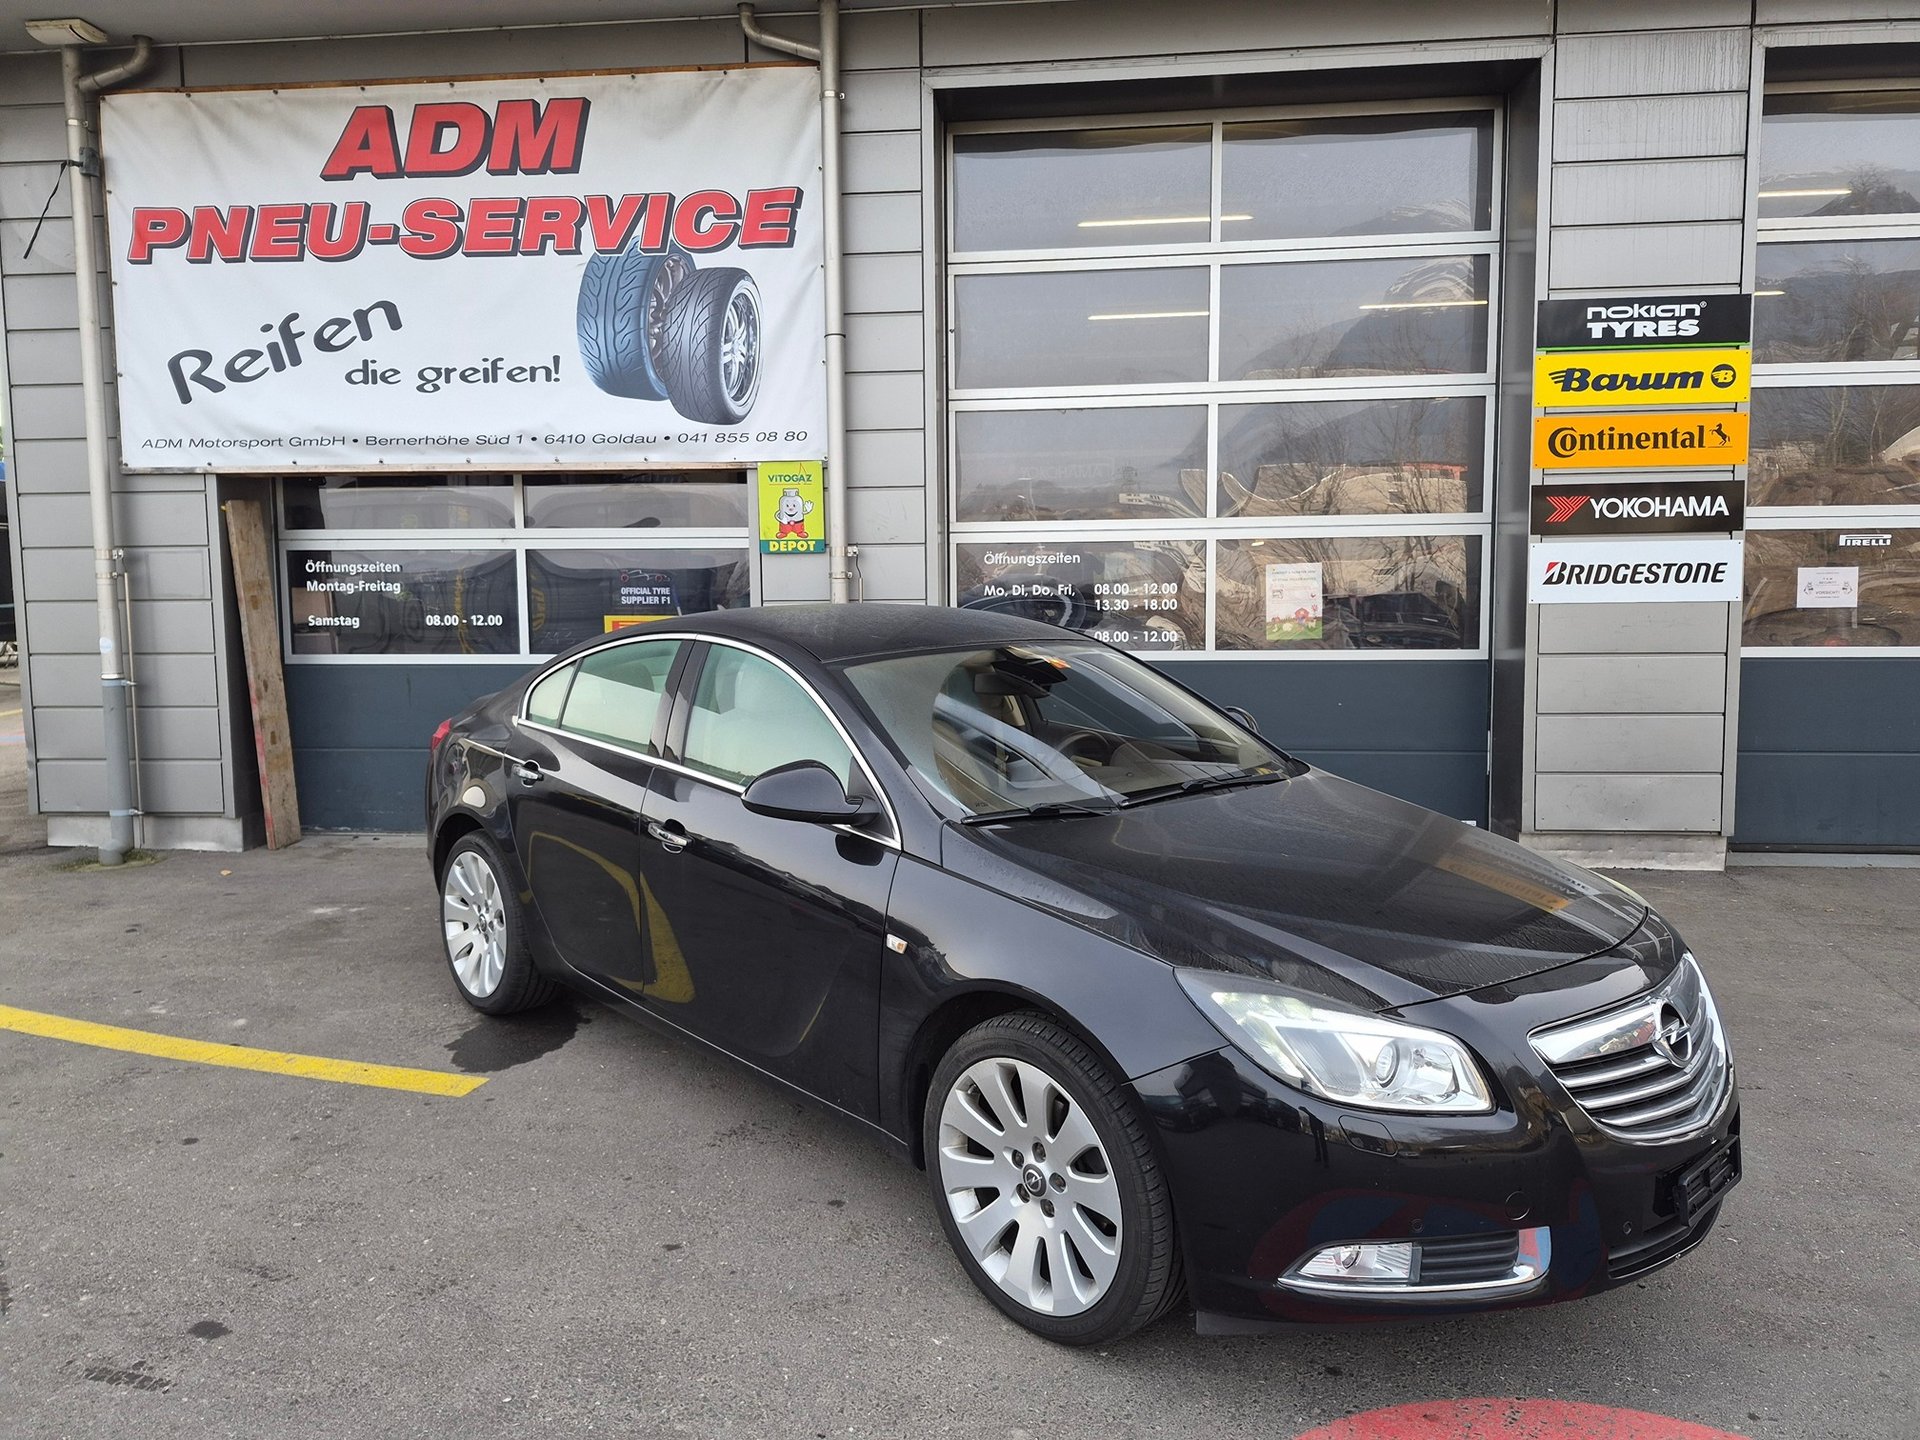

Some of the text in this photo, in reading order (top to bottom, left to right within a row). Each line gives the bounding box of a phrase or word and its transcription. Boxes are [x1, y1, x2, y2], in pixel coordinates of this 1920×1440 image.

[319, 97, 592, 182] ADM
[127, 187, 804, 265] PNEU-SERVICE
[1587, 319, 1700, 339] TYRES
[166, 300, 403, 405] Reifen
[344, 355, 561, 394] die greifen!
[1548, 367, 1704, 393] Barum
[141, 430, 808, 450] ADM Motorsport GmbH Bernerhöhe Süd 1 6410 Goldau 041 855 08 80
[1548, 424, 1706, 459] Continental
[1590, 495, 1730, 518] YOKOHAMA
[769, 541, 815, 551] DEPOT
[1839, 534, 1892, 547] PIRELLI
[984, 550, 1081, 566] Öffnungszeiten
[305, 560, 401, 575] Öffnungszeiten
[1543, 561, 1728, 585] BRIDGESTONE
[306, 580, 401, 594] Montag-Freitag
[621, 587, 671, 595] OFFICIAL TYRE
[984, 585, 1008, 597] Mo,
[1012, 584, 1028, 597] Di,
[1032, 585, 1054, 597] Do,
[1057, 584, 1076, 597] Fri,
[1094, 583, 1129, 595] 08.00
[1143, 583, 1178, 595] 12.00
[621, 596, 671, 605] SUPPLIER F1
[1095, 599, 1129, 611] 13.30
[1143, 598, 1178, 610] 18.00
[308, 615, 360, 628] Samstag
[426, 615, 459, 626] 08.00
[471, 615, 503, 626] 12.00
[1094, 631, 1129, 642] 08.00
[1143, 631, 1178, 642] 12.00
